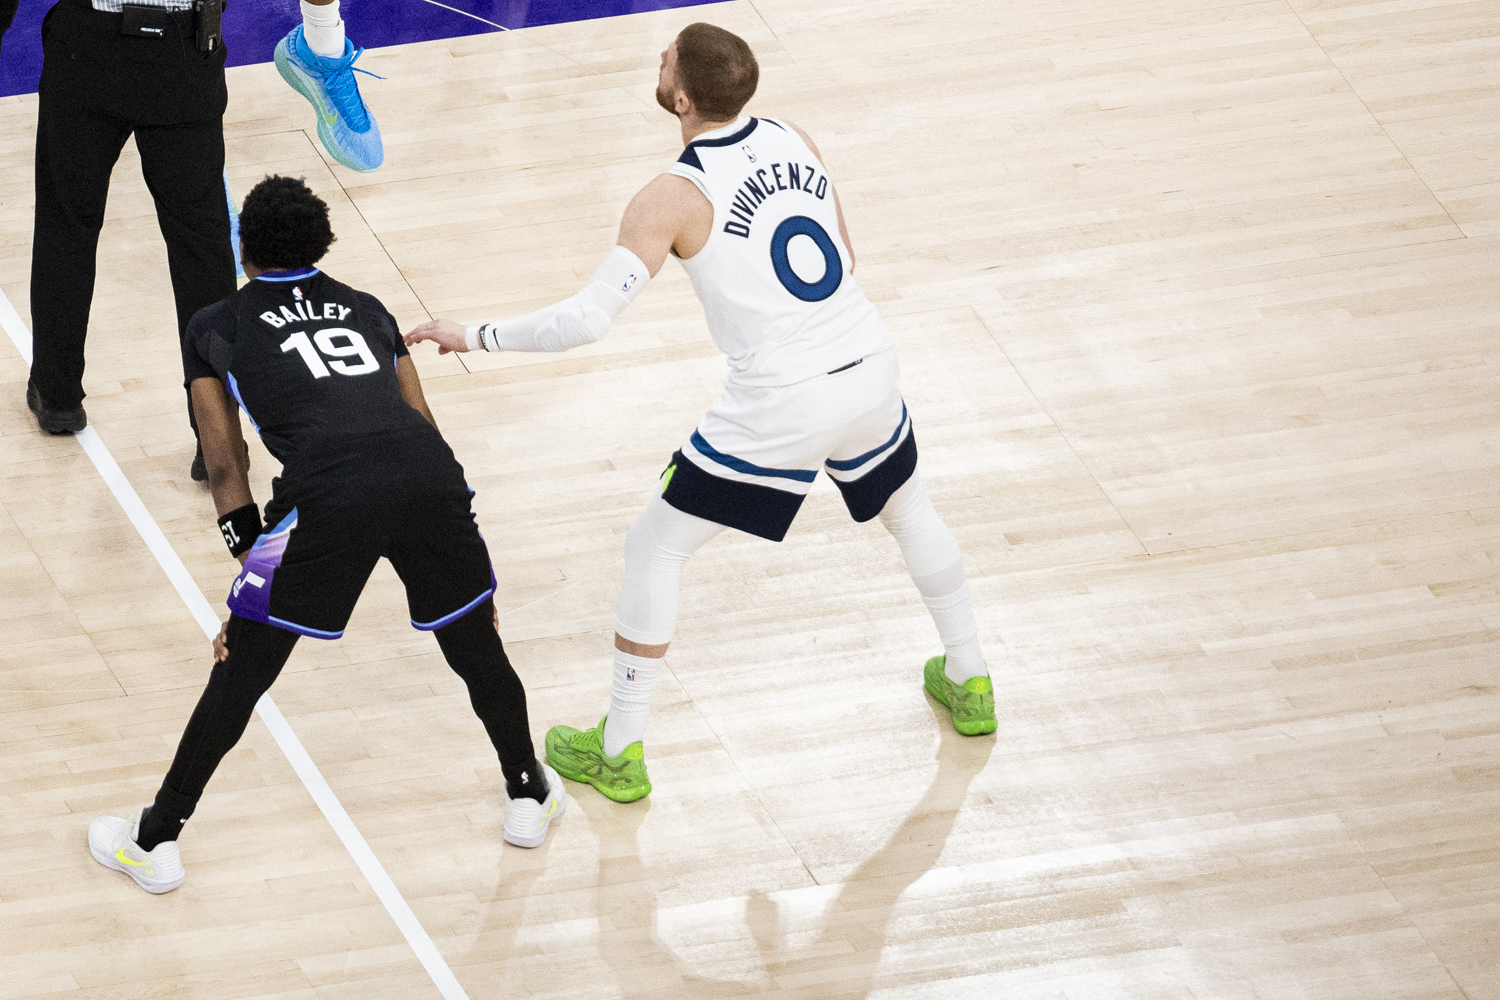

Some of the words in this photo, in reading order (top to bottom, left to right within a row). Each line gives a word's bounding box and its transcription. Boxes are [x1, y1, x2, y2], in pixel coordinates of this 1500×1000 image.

[723, 162, 828, 238] DIVINCENZO
[769, 215, 843, 303] 0
[259, 300, 352, 329] BAILEY
[280, 327, 380, 379] 19
